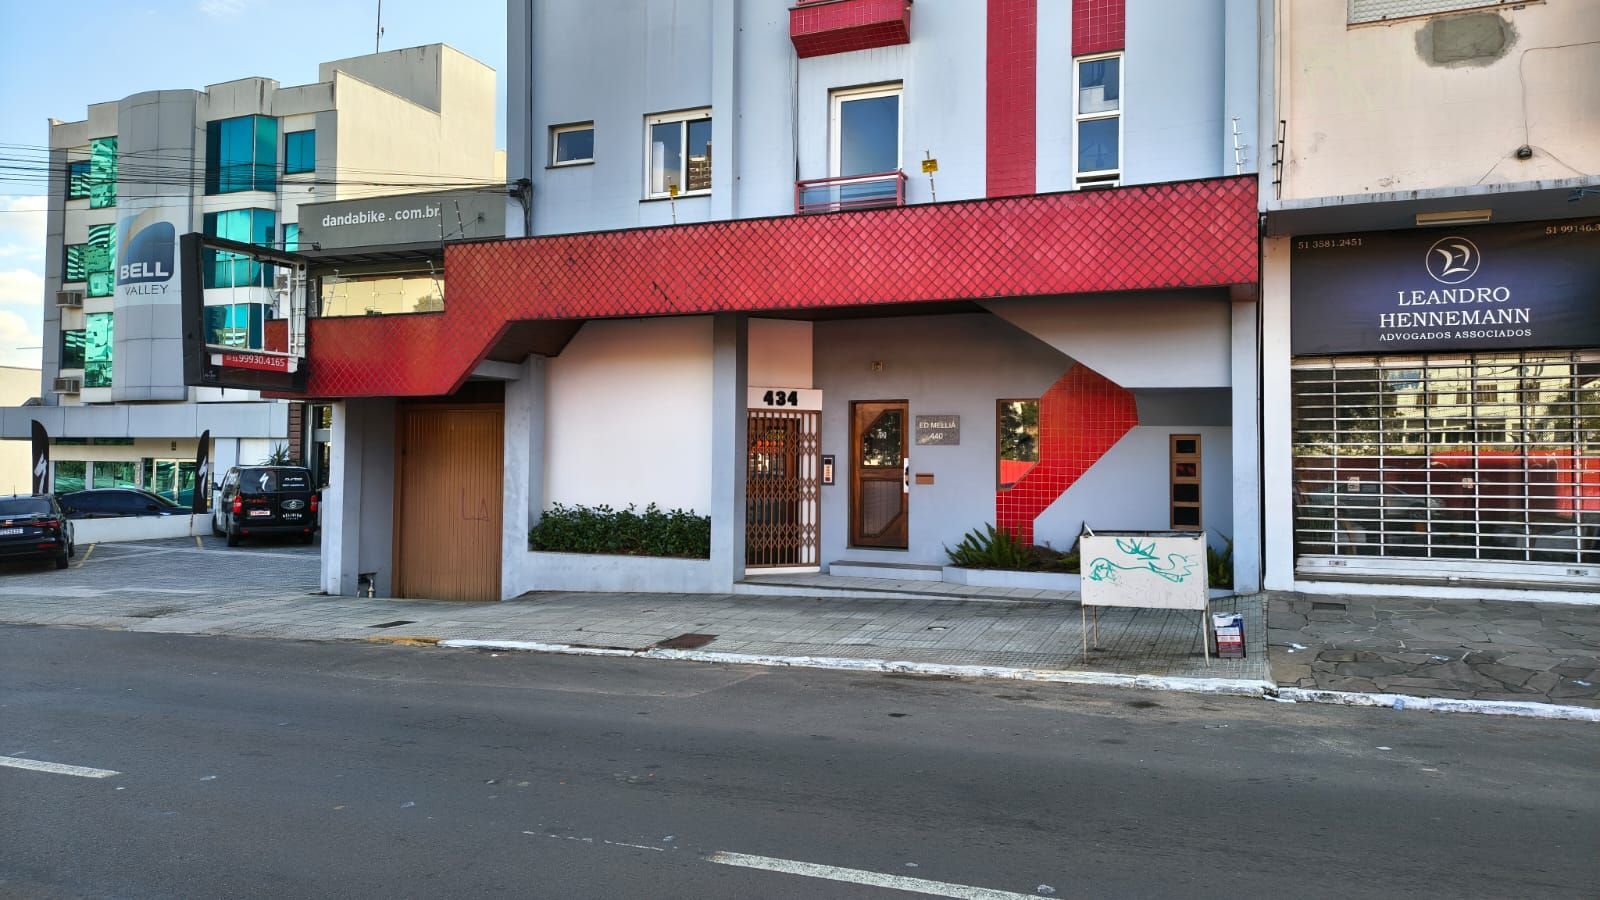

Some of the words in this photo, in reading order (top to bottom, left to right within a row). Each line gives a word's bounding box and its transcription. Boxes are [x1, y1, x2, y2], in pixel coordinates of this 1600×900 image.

[322, 211, 385, 227] dandabike
[1298, 241, 1309, 249] 51
[1312, 238, 1362, 249] 3581.2451
[120, 261, 169, 280] BELL
[125, 284, 169, 296] VALLEY
[1398, 286, 1511, 306] LEANDRO
[1379, 308, 1531, 328] HENNEMANN
[1379, 331, 1451, 341] ADVOGADOS
[1454, 328, 1532, 340] ASSOCIADOS
[763, 390, 798, 406] 434
[919, 421, 929, 429] ED
[929, 432, 944, 440] 440
